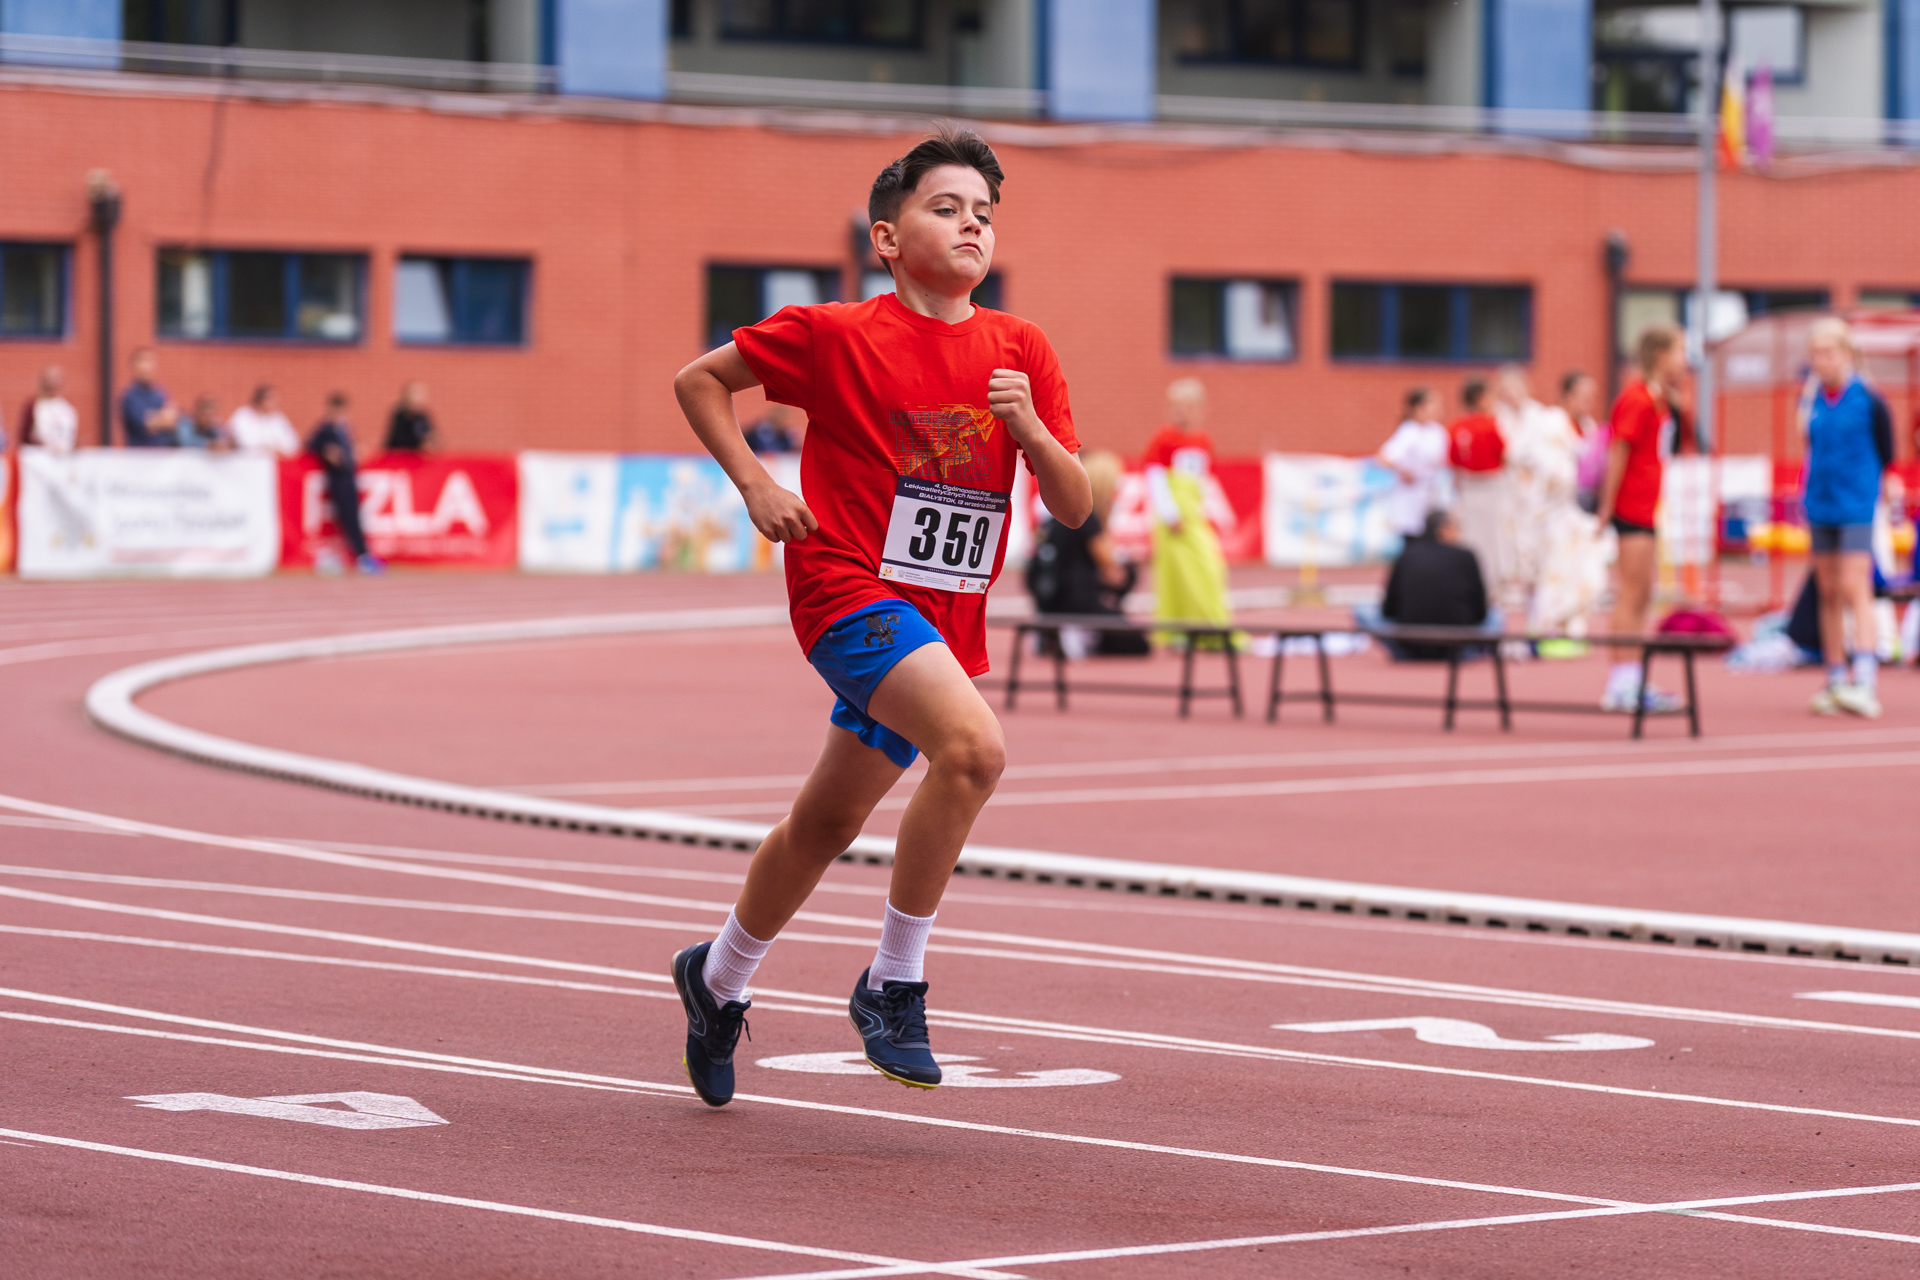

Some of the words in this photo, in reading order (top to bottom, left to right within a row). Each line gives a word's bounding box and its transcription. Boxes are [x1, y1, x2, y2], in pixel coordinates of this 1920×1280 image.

[908, 507, 990, 569] 359
[1270, 1016, 1656, 1051] 2
[121, 1091, 450, 1129] 4
